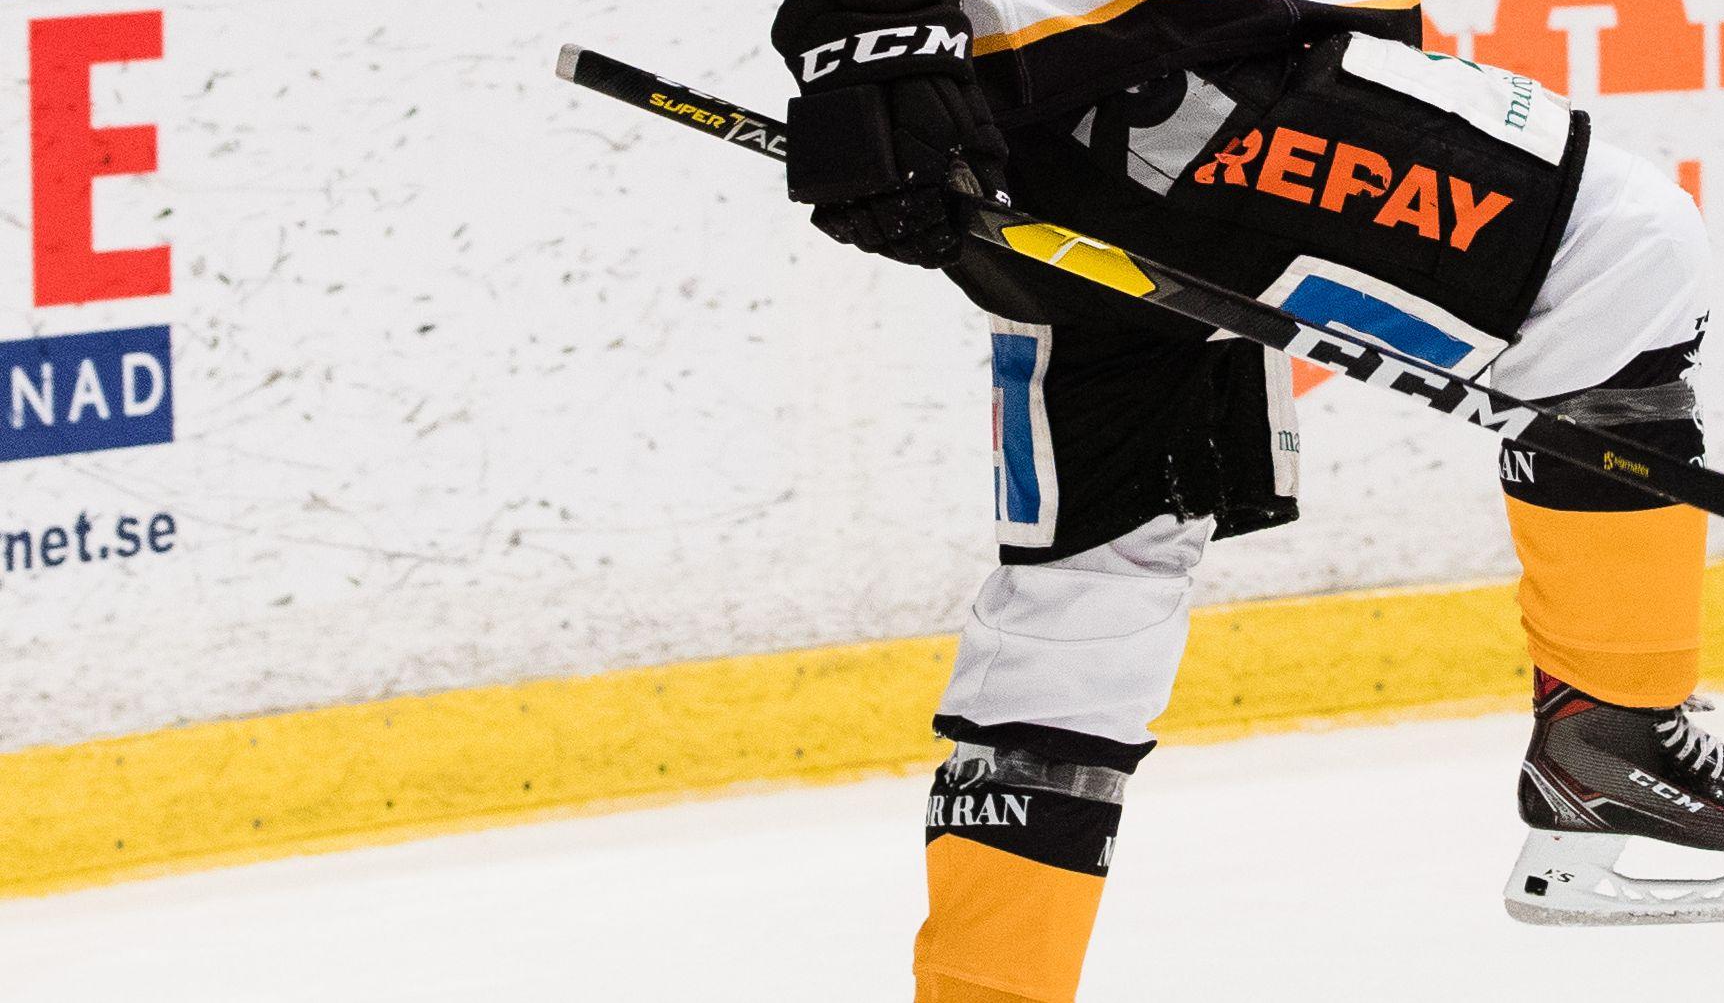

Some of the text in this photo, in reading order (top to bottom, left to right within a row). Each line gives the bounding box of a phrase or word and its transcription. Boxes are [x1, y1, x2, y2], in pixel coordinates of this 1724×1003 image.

[800, 25, 969, 83] CCM
[648, 92, 726, 130] SUPER
[29, 10, 171, 307] E
[11, 352, 165, 429] NAD
[1283, 321, 1539, 442] CCM
[1627, 767, 1705, 814] CCM
